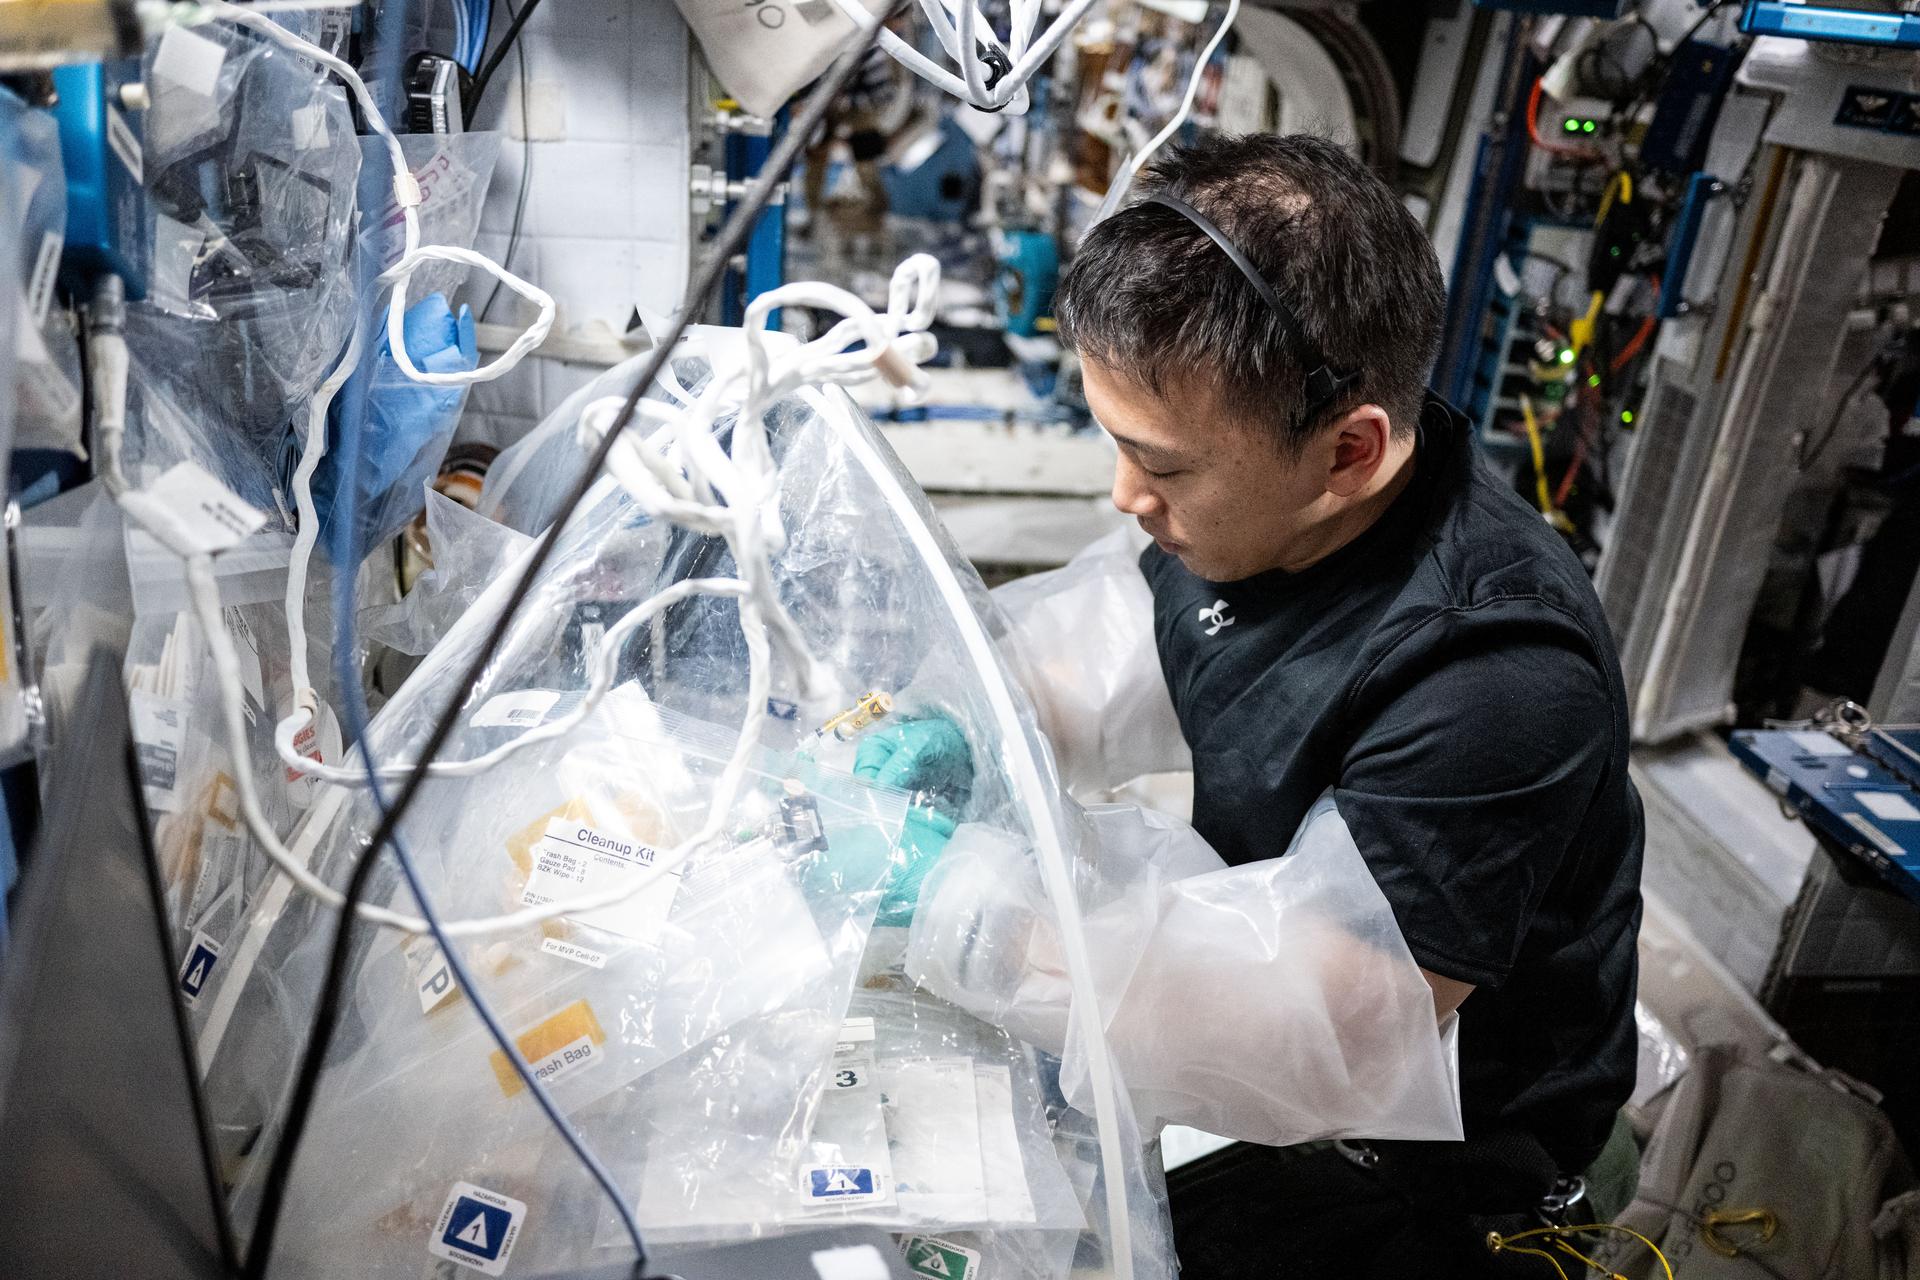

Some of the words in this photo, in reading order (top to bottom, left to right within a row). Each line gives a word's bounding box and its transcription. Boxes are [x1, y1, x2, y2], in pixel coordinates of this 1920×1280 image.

[577, 829, 632, 855] Cleanup
[636, 846, 656, 863] Kit
[540, 856, 562, 868] Gauze
[562, 862, 576, 873] Pad
[562, 855, 577, 866] Bag
[553, 868, 570, 879] Wipe
[546, 942, 558, 950] For
[559, 945, 575, 955] MVP
[575, 950, 600, 962] Cell-07
[422, 965, 450, 995] P
[534, 1058, 563, 1081] rash
[564, 1044, 592, 1066] Bag
[836, 1070, 858, 1088] 3
[473, 1190, 507, 1207] HAZARDOUS
[437, 1201, 455, 1232] MATERIAL
[472, 1223, 482, 1241] 1
